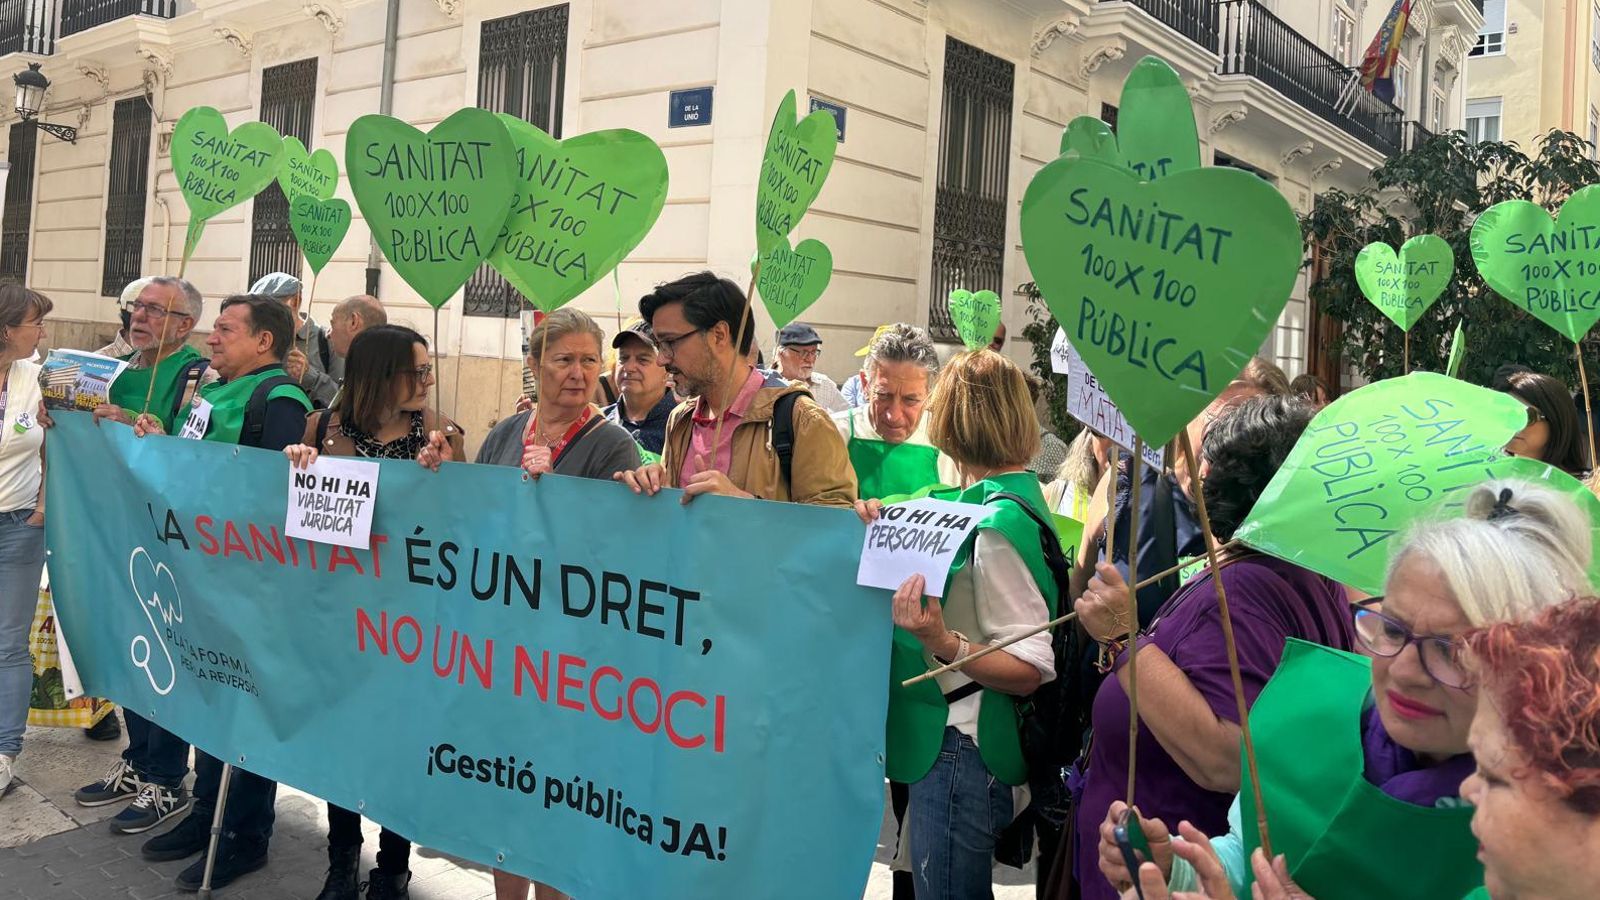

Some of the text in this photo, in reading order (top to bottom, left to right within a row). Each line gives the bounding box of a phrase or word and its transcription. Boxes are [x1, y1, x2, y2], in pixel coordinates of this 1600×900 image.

[294, 472, 371, 498] NO HI HA
[297, 491, 365, 518] VIABILITAT
[877, 505, 973, 531] NO HI HA
[868, 524, 952, 557] PERSONAL
[147, 502, 191, 550] LA
[405, 525, 459, 591] ÉS
[470, 547, 542, 611] UN
[560, 563, 713, 656] DRET,
[356, 607, 726, 753] NO UN NEGOCI
[427, 743, 727, 862] ¡Gestió pública JA!
